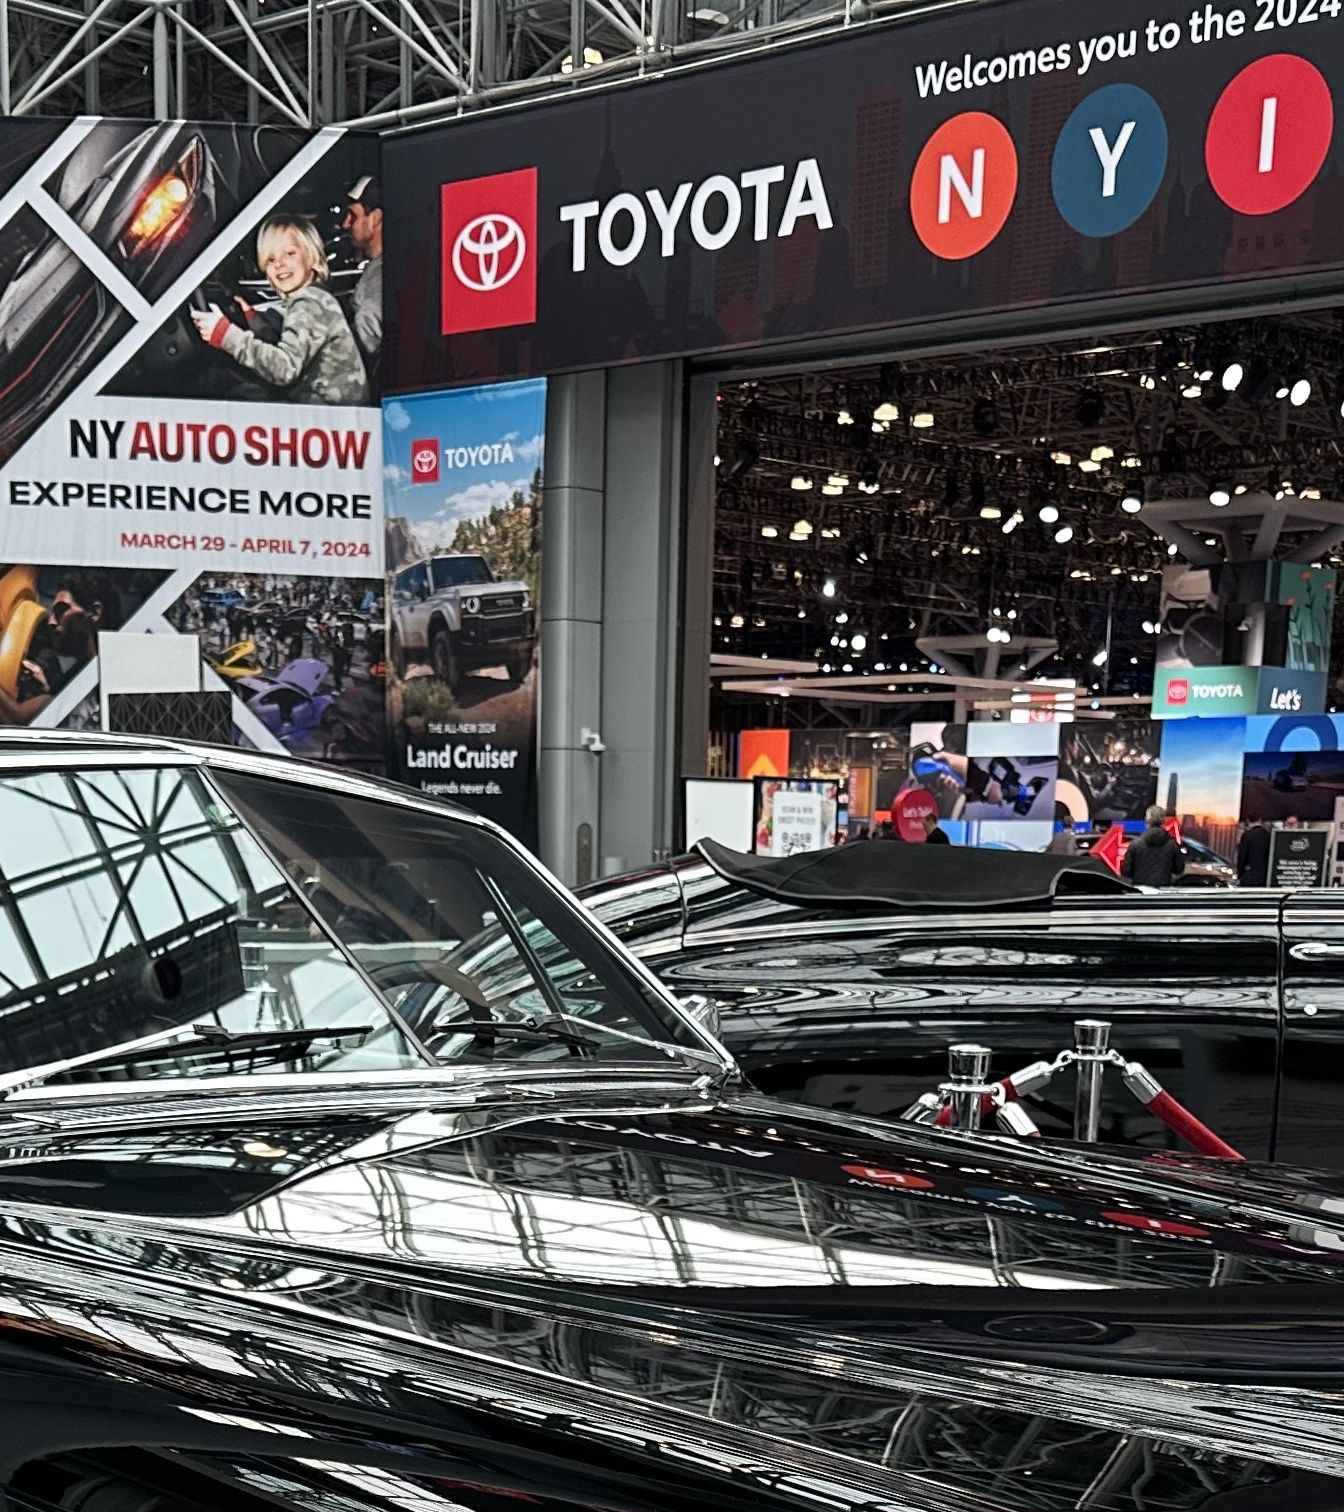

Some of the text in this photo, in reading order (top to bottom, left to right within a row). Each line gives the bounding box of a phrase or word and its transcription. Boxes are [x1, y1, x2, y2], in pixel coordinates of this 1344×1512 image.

[914, 0, 1343, 98] Welcomes you to the 2024
[560, 158, 834, 273] TOYOTA
[244, 425, 371, 470] SHOW
[444, 443, 514, 469] TOYOTA
[9, 480, 372, 520] EXPERIENCE MORE
[120, 532, 196, 550] MARCH
[201, 536, 226, 551] 29
[241, 538, 298, 554] APRIL
[321, 541, 371, 558] 2024
[1191, 684, 1243, 699] TOYOTA
[1269, 687, 1302, 711] Let's
[407, 743, 518, 769] Land Cruiser
[420, 781, 459, 796] Legends
[460, 783, 484, 795] never
